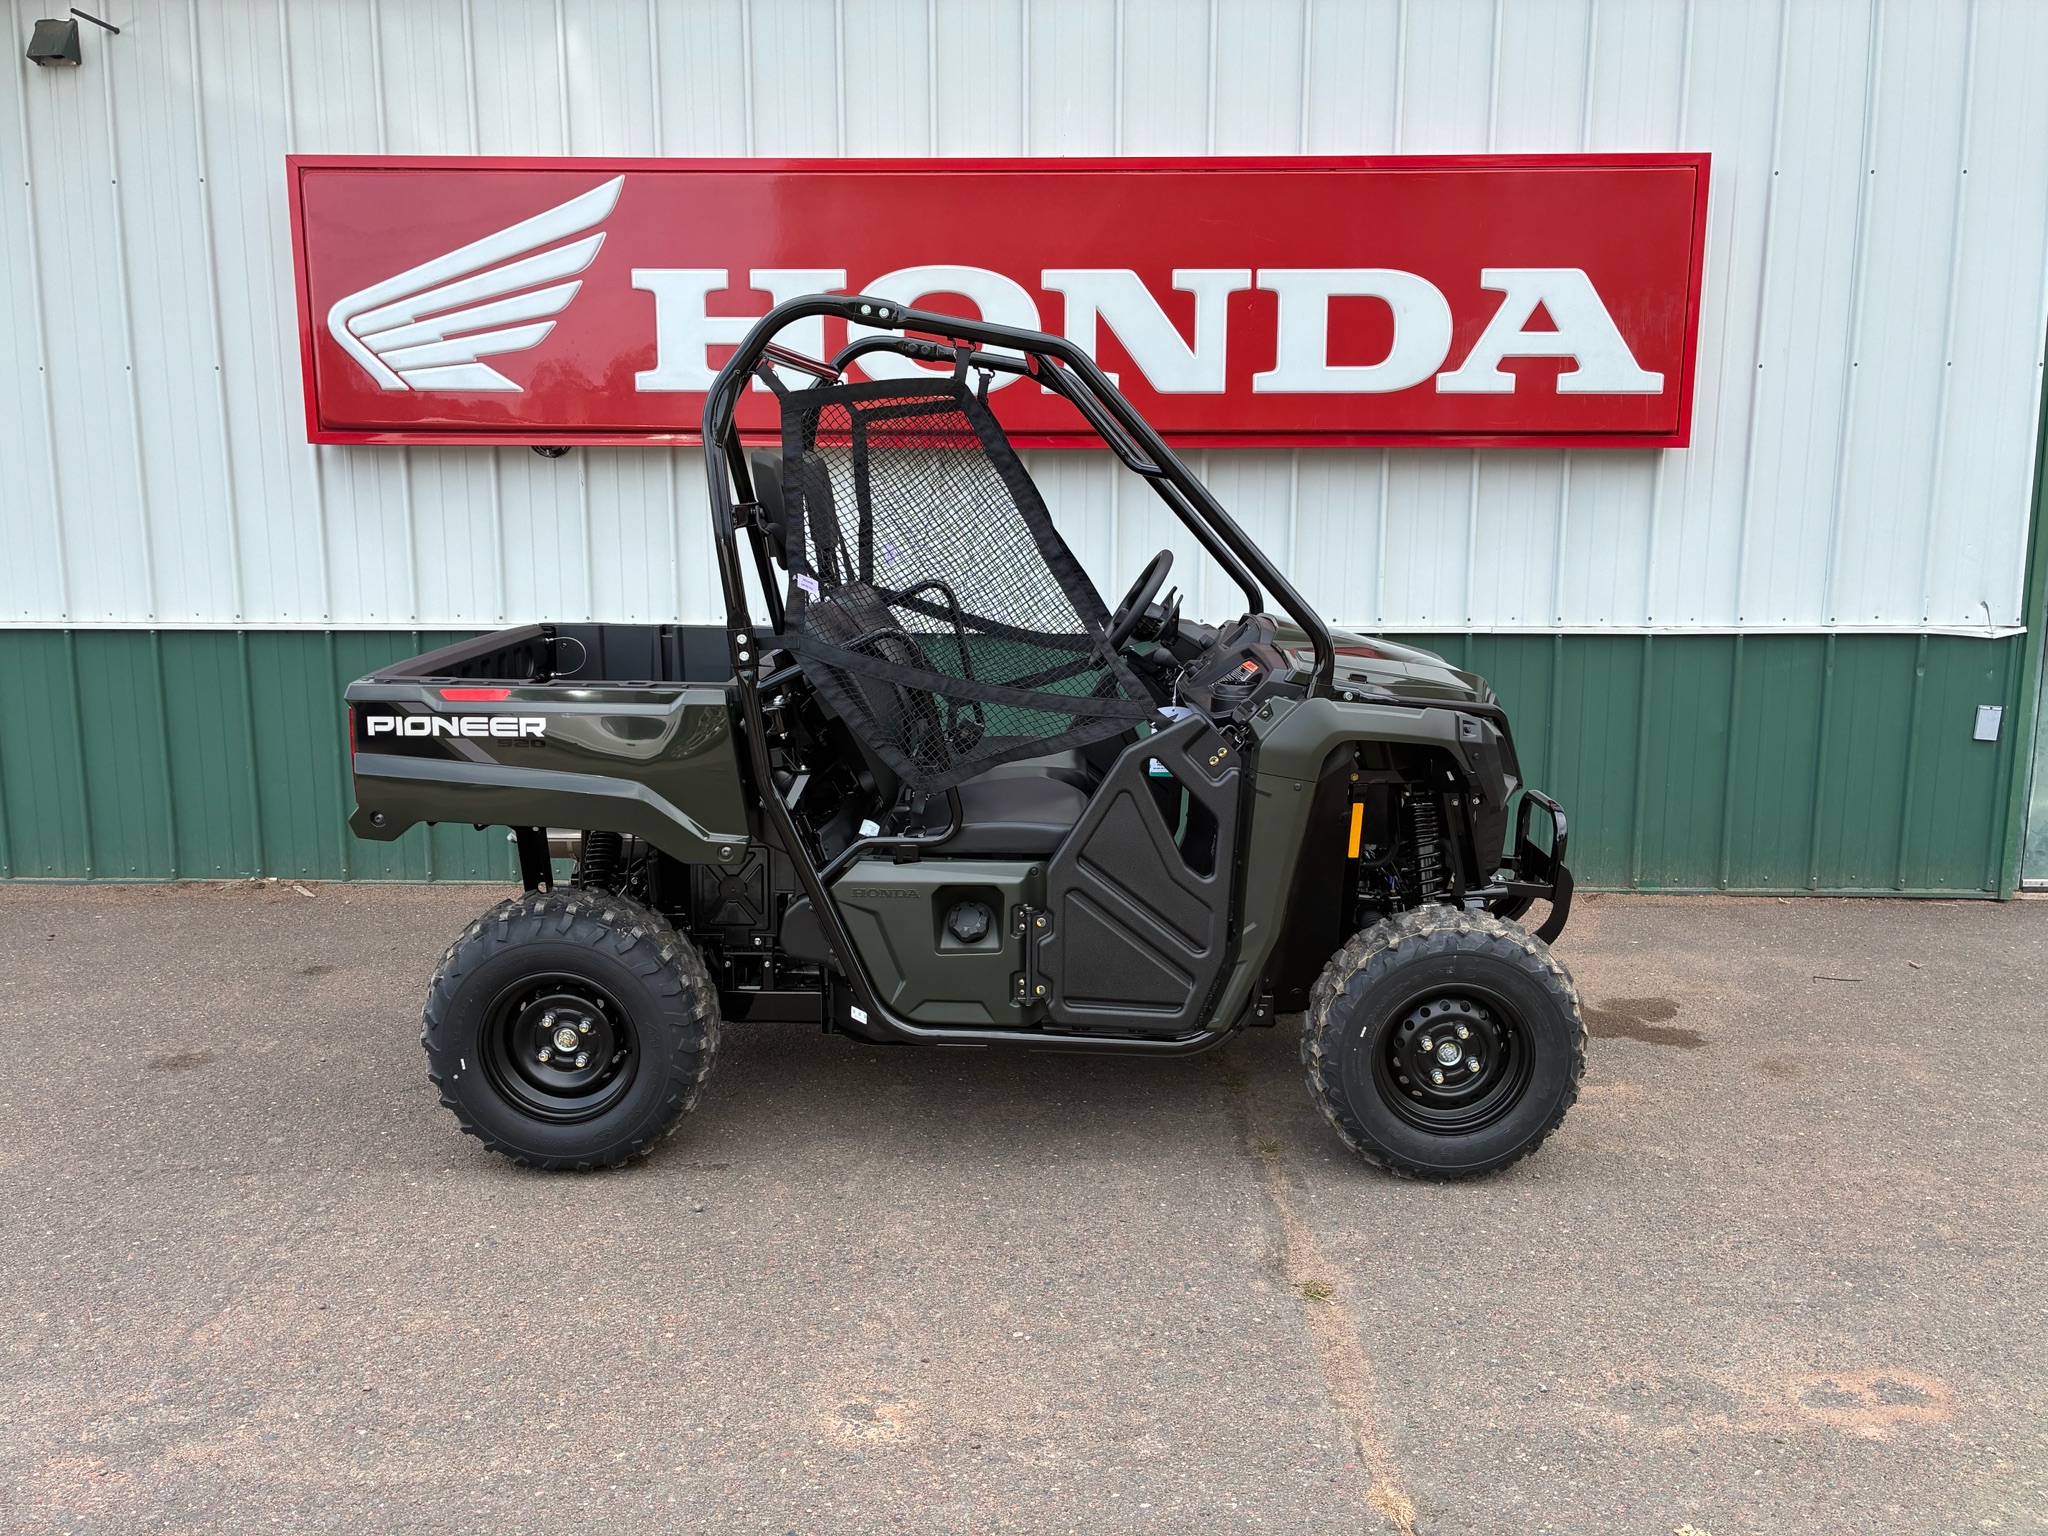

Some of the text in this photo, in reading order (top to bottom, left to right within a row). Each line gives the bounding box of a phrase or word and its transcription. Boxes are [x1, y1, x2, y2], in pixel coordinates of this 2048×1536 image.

[631, 265, 1665, 394] HONDA
[366, 715, 547, 738] PIONEER
[497, 738, 547, 749] 520
[851, 887, 921, 898] HONDA
